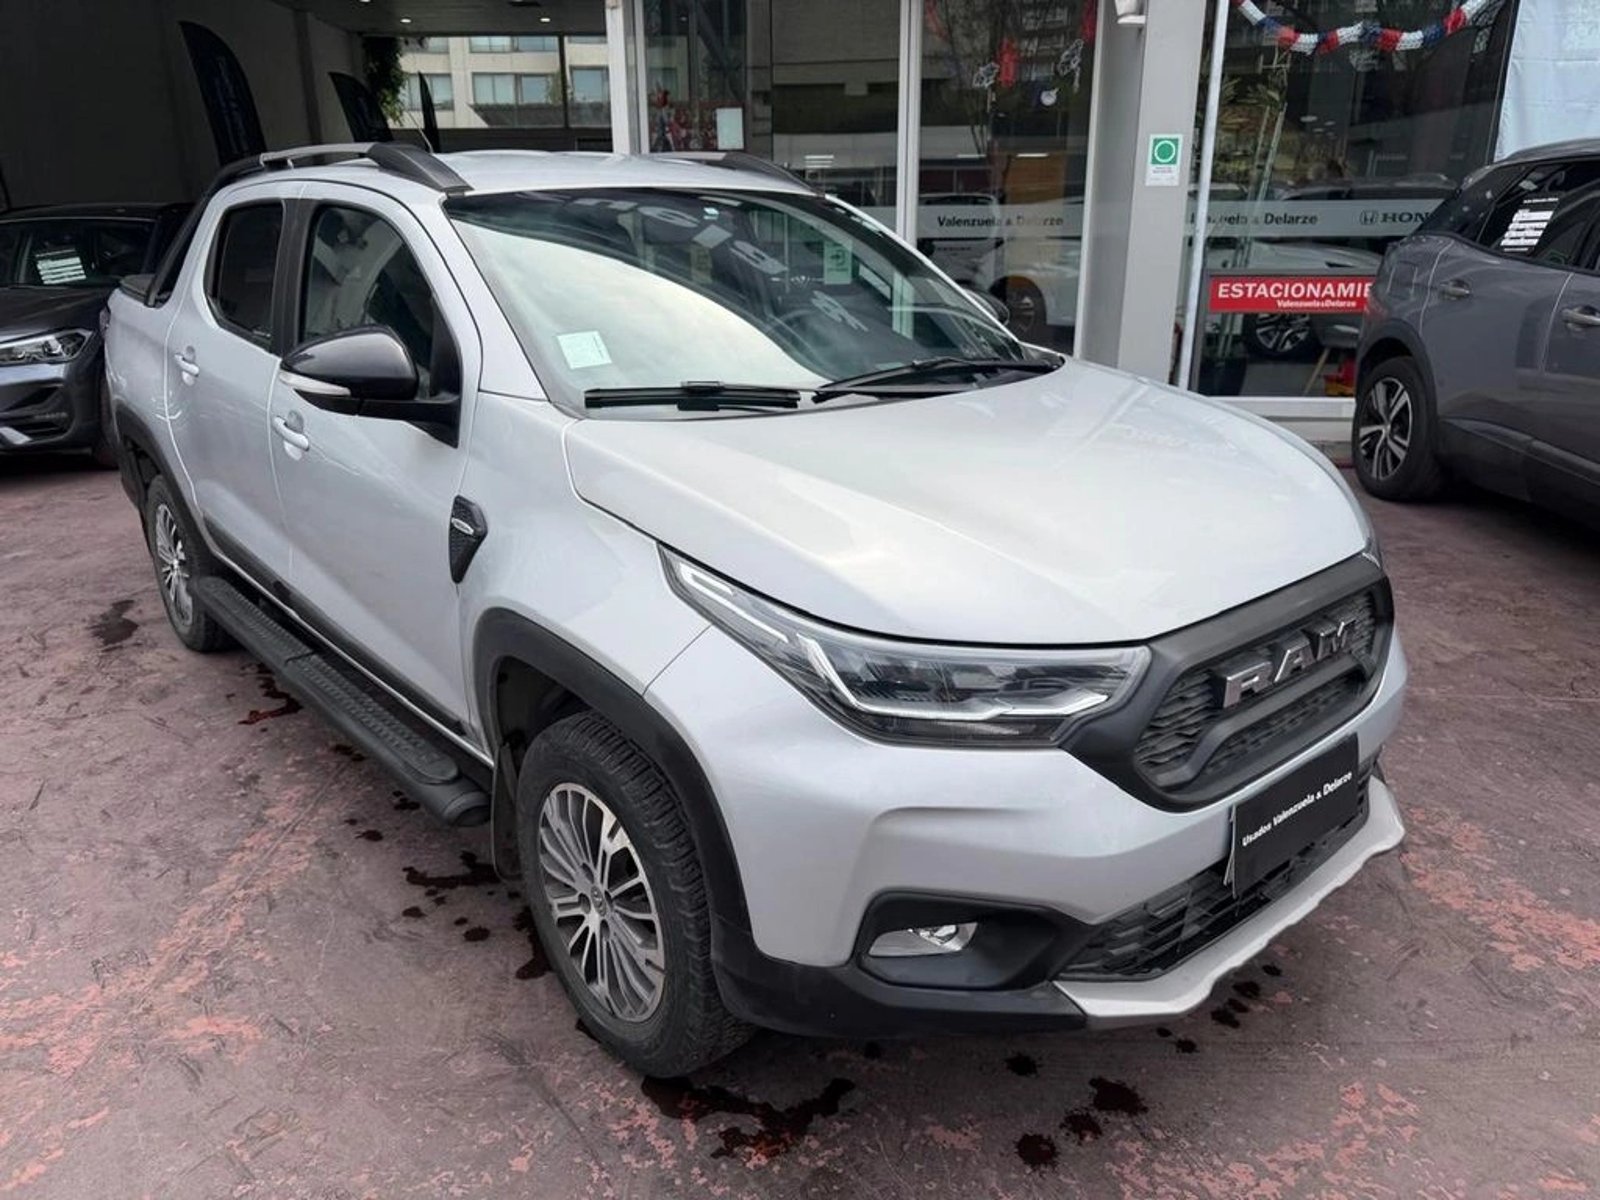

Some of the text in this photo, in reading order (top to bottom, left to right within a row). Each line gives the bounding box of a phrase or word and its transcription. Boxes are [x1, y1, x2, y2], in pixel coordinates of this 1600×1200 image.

[1264, 212, 1319, 226] Delarze
[1221, 619, 1356, 709] RAM
[1242, 822, 1272, 847] Usados
[1273, 794, 1315, 826] Valenzuela
